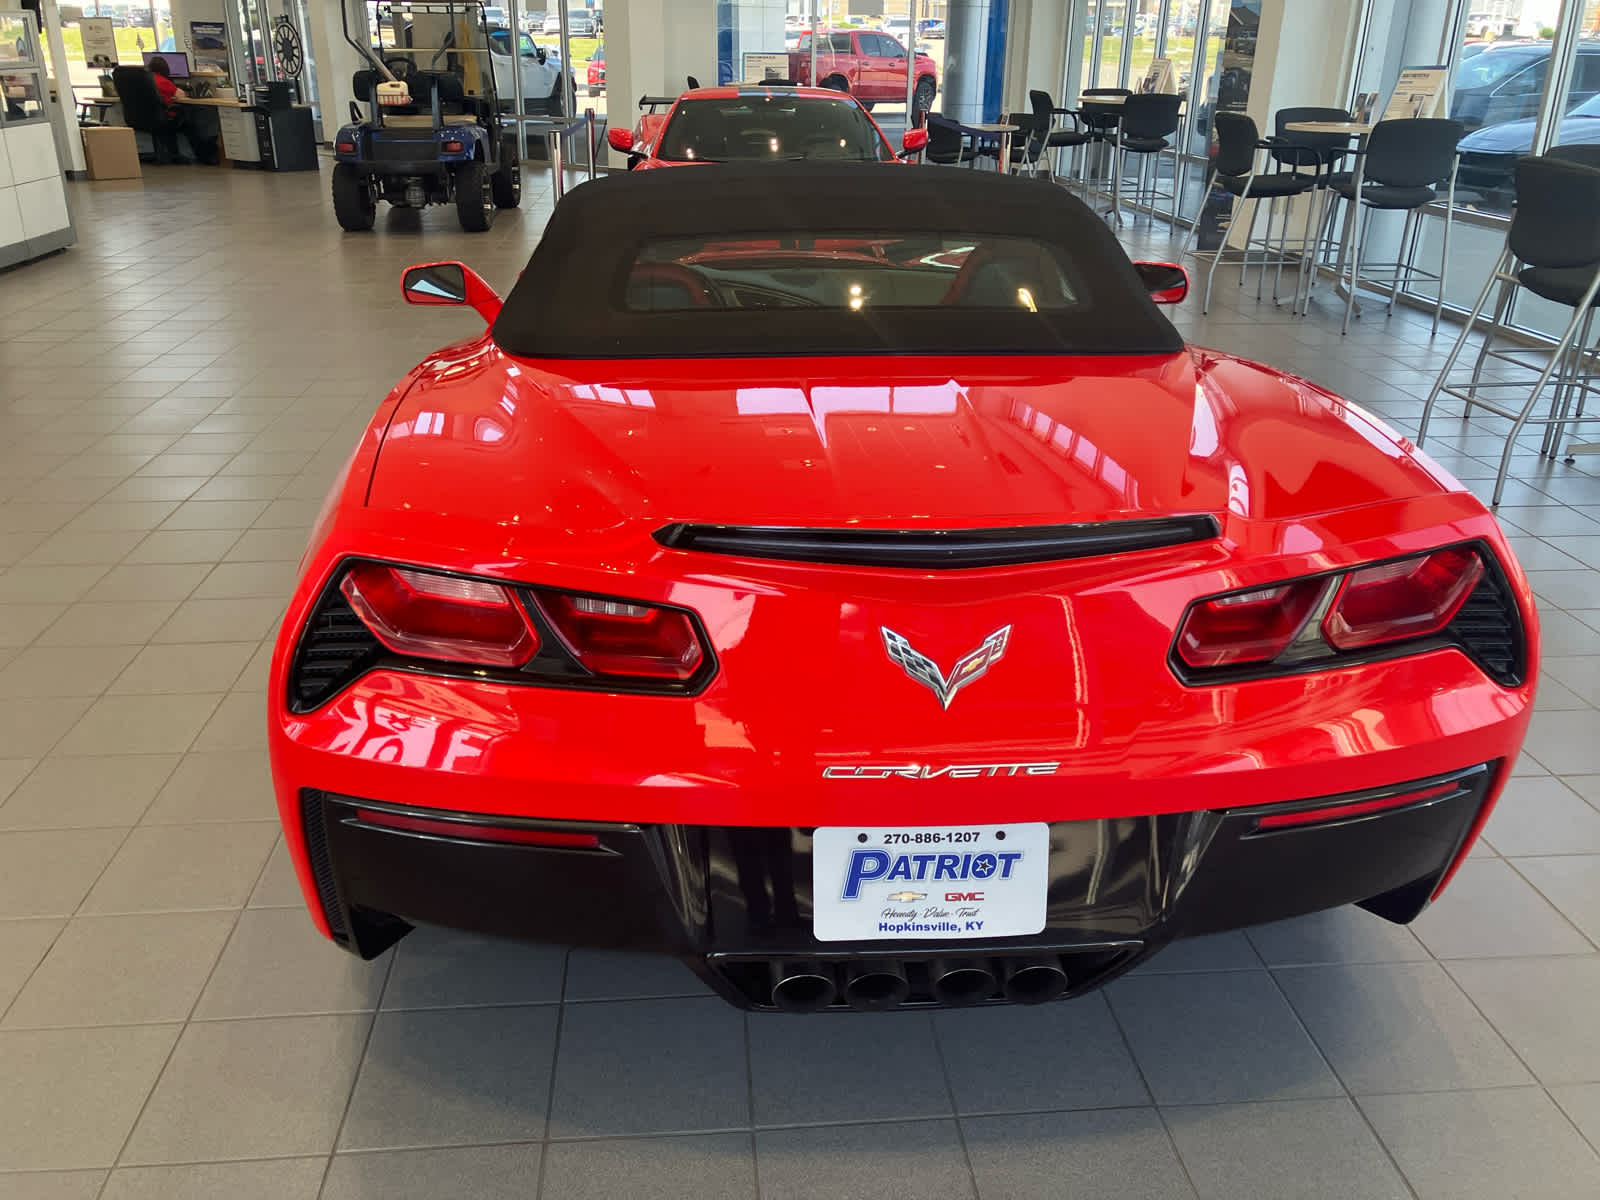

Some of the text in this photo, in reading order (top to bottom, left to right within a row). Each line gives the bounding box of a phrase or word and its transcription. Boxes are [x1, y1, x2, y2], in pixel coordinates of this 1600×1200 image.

[822, 762, 1061, 779] CORVETTE
[883, 832, 981, 844] 270-886-1207
[841, 848, 1024, 901] PATRIOT
[944, 891, 985, 902] GMC
[956, 907, 981, 918] Trust
[878, 920, 984, 934] Hopkinsville, KY
